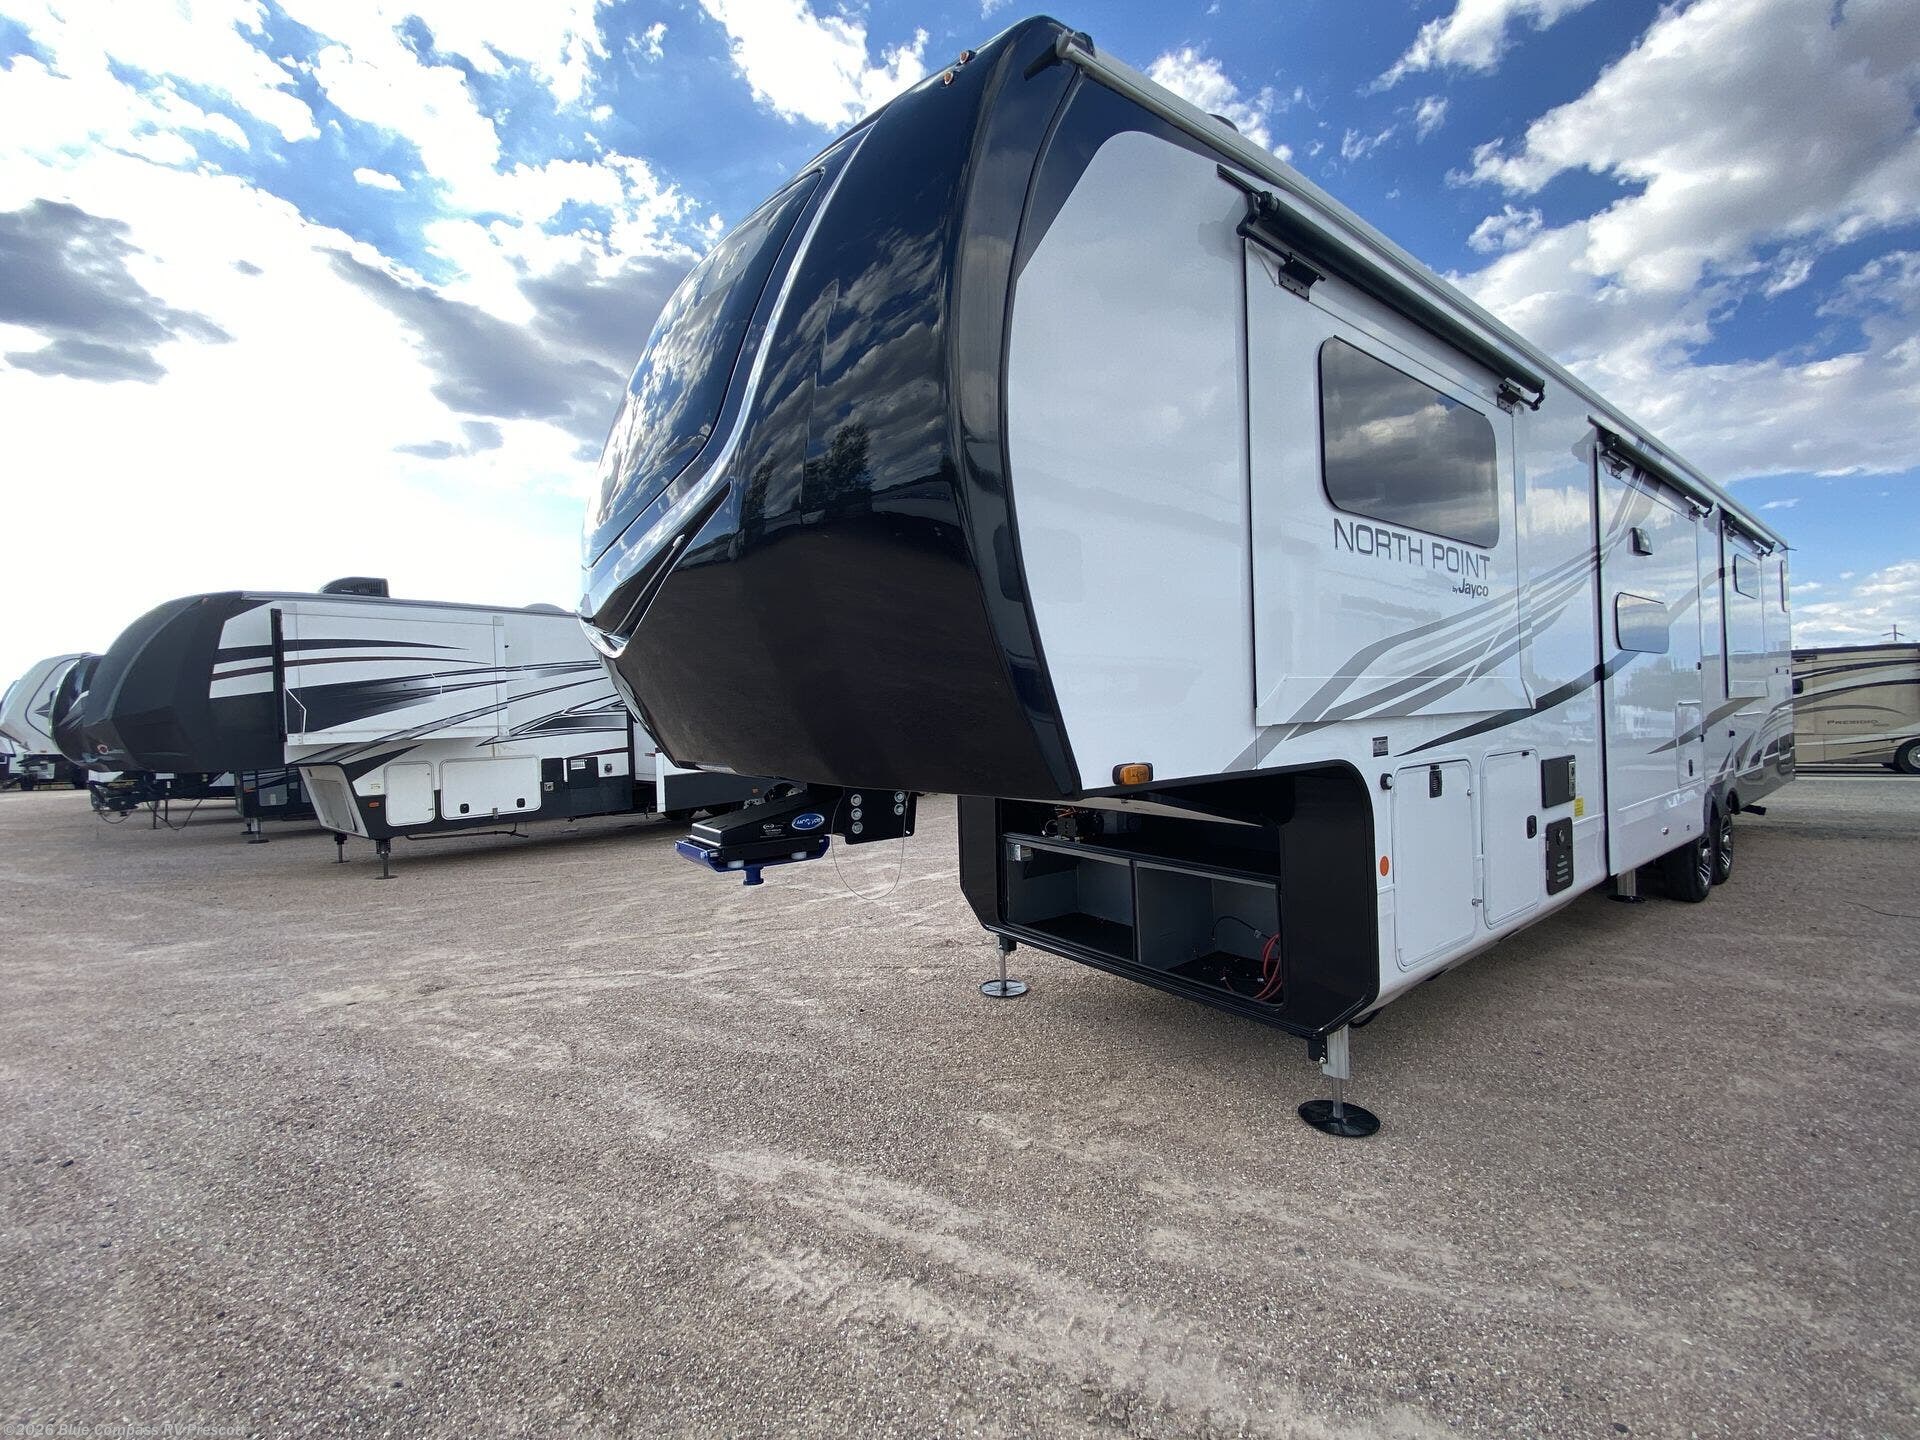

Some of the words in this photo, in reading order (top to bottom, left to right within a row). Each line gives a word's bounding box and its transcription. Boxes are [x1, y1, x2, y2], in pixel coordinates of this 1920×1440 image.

[1333, 518, 1424, 566] NORTH
[1432, 542, 1490, 580] POINT
[1459, 578, 1489, 598] Jayco
